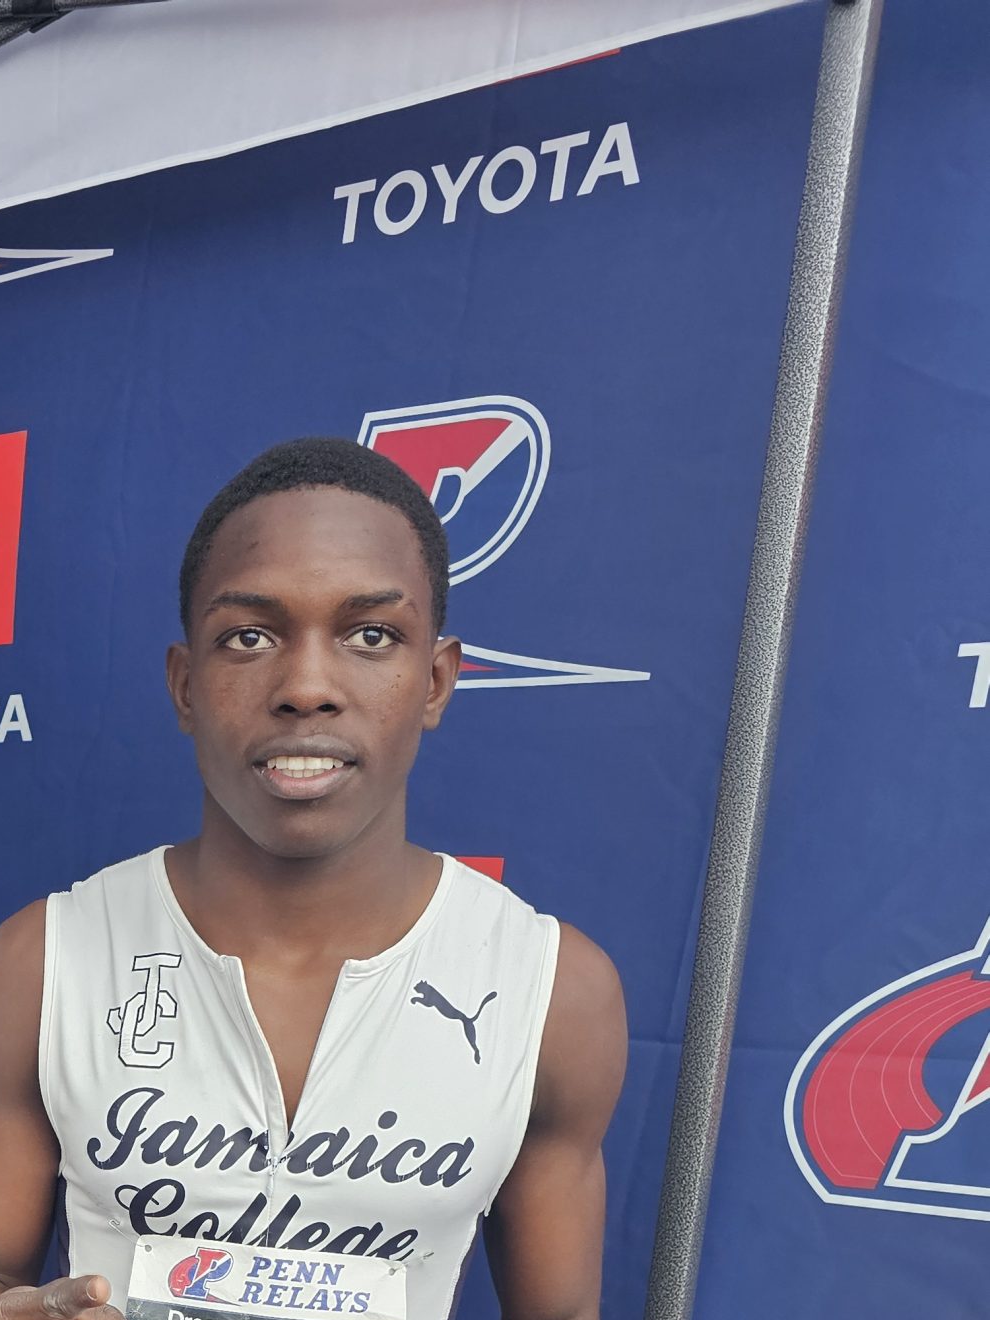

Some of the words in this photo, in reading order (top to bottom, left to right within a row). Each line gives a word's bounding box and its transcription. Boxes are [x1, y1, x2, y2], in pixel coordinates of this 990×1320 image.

[332, 121, 641, 244] TOYOTA
[87, 1087, 475, 1188] Jamaica
[238, 1280, 371, 1314] RELAYS
[246, 1256, 345, 1286] PENN
